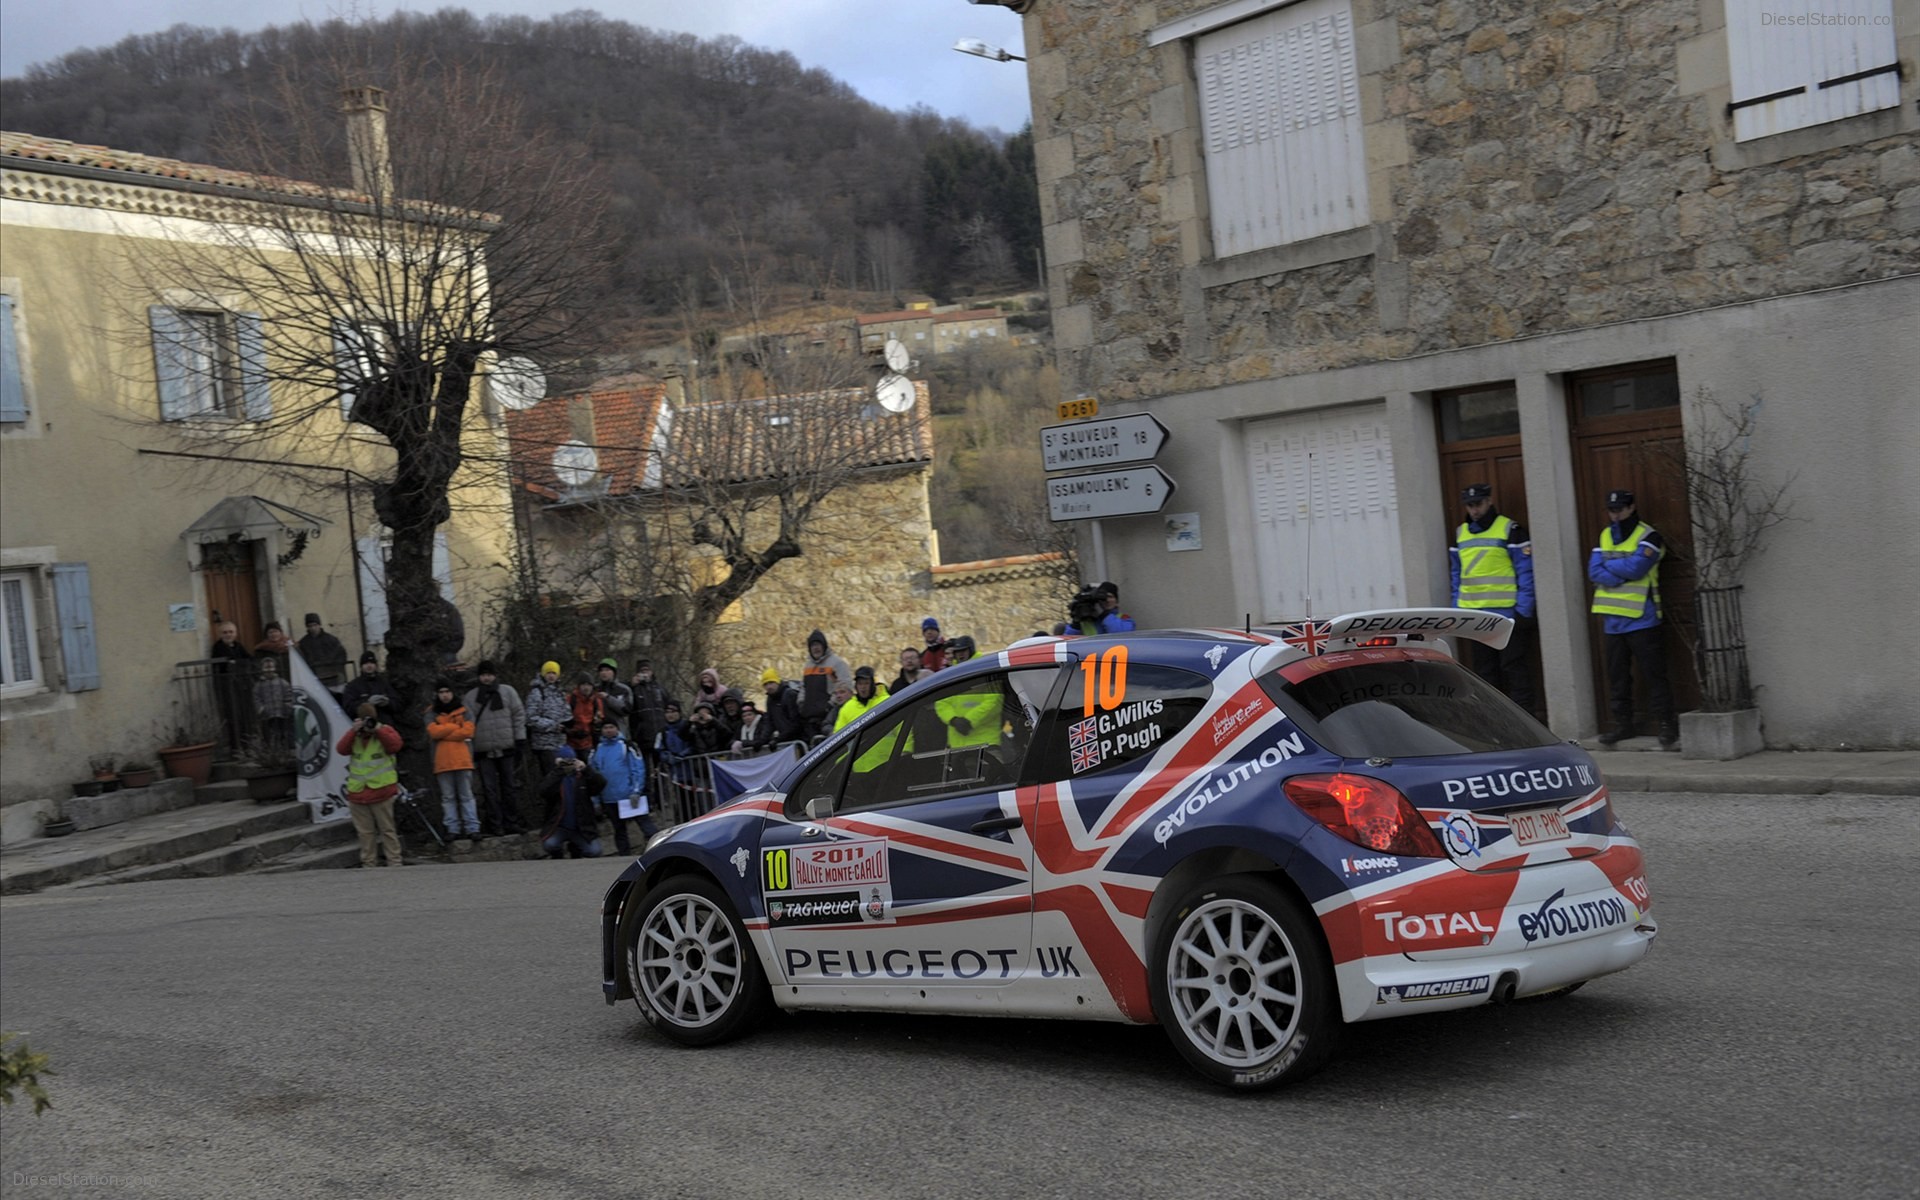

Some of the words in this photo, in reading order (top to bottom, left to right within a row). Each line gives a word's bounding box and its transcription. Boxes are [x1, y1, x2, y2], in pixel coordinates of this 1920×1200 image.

[1060, 405, 1069, 418] D
[1071, 402, 1095, 417] 261
[1061, 426, 1119, 446] SAUVEUR
[1133, 431, 1148, 445] 18
[1059, 443, 1121, 462] MONTAGUT
[1050, 477, 1130, 495] ISSAMOULENC
[1144, 483, 1153, 497] 6
[1344, 616, 1475, 634] PEUGEOT
[1473, 616, 1504, 632] UK
[1080, 644, 1129, 719] 10
[1098, 698, 1165, 735] G.Wilks
[1100, 723, 1162, 760] P.Pugh
[1441, 766, 1572, 803] PEUGEOT
[1574, 764, 1596, 786] UK
[811, 847, 865, 864] 2011
[1340, 856, 1399, 873] KRONOS
[766, 848, 789, 890] 10
[795, 857, 824, 886] RALLYE
[824, 849, 884, 884] MONTE-CARLO
[1374, 911, 1495, 942] TOTAL
[784, 948, 1018, 979] PEUGEOT
[1035, 946, 1081, 979] UK
[1404, 976, 1489, 998] MICHELIN
